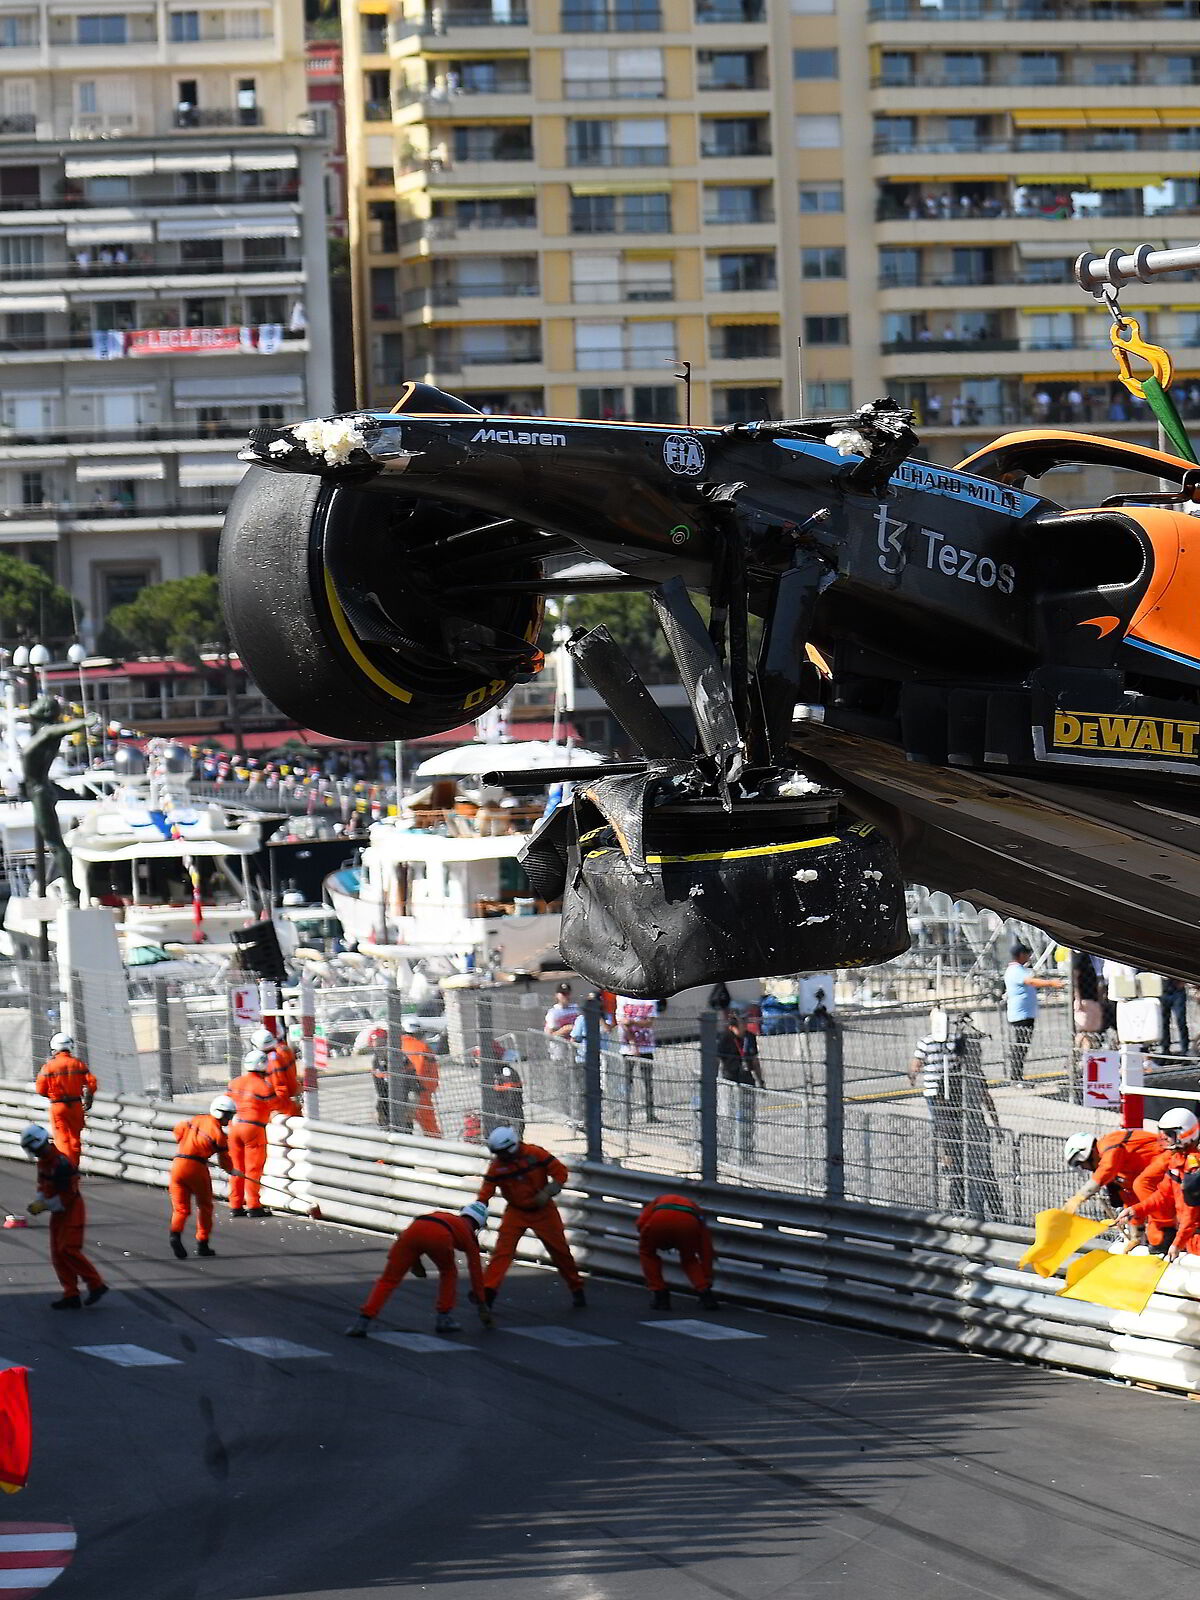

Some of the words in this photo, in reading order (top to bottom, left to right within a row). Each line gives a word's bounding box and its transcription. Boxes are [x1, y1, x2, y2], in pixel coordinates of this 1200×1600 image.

[148, 328, 224, 347] LECLERC
[470, 428, 567, 447] McLaren
[893, 466, 961, 493] ICHARD
[920, 528, 1016, 594] Tezos
